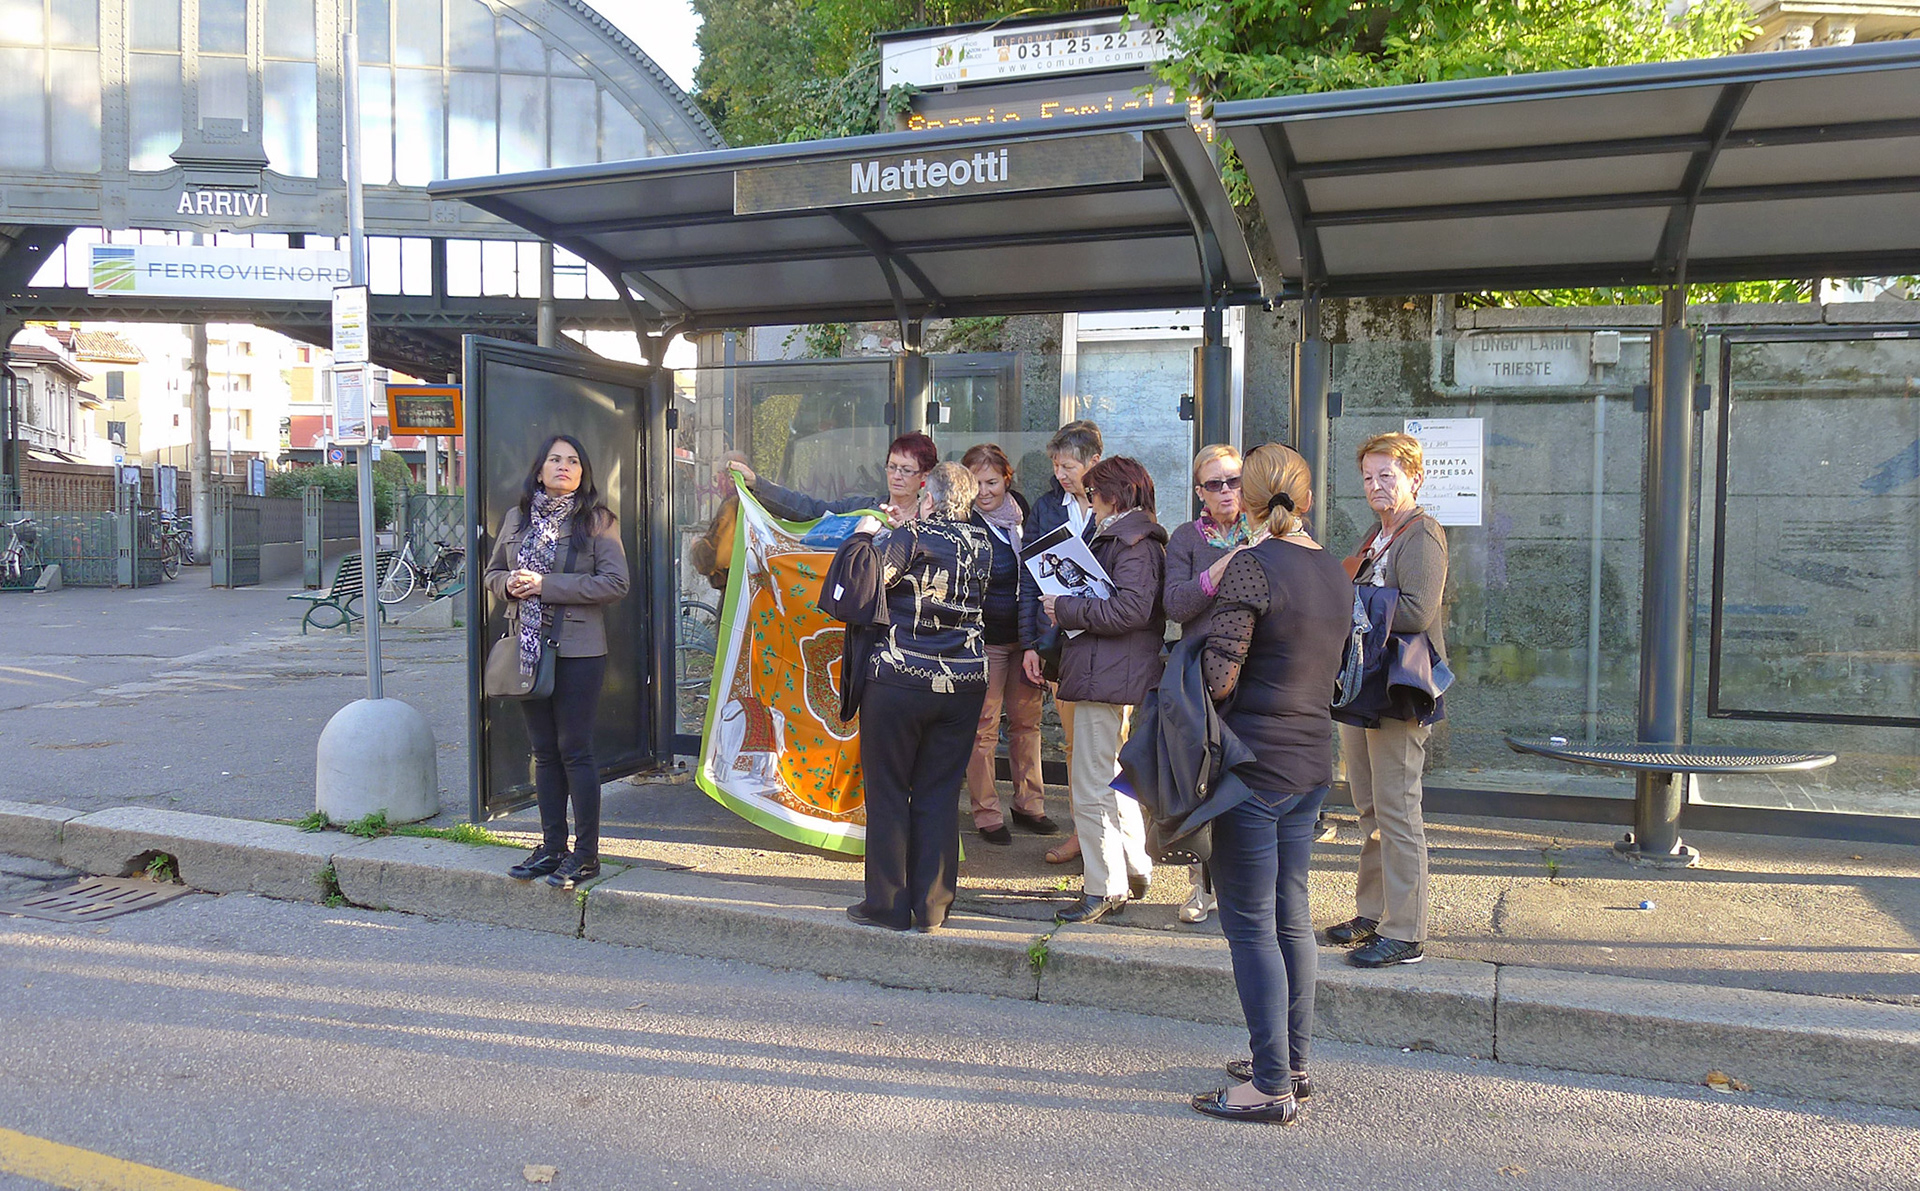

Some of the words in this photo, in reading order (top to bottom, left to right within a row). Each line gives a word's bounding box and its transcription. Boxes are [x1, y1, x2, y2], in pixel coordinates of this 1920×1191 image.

[995, 30, 1090, 47] INFORMAZIONI
[851, 148, 1008, 194] Matteotti
[177, 191, 269, 217] ARRIVI
[149, 262, 350, 283] FERROVIENORD
